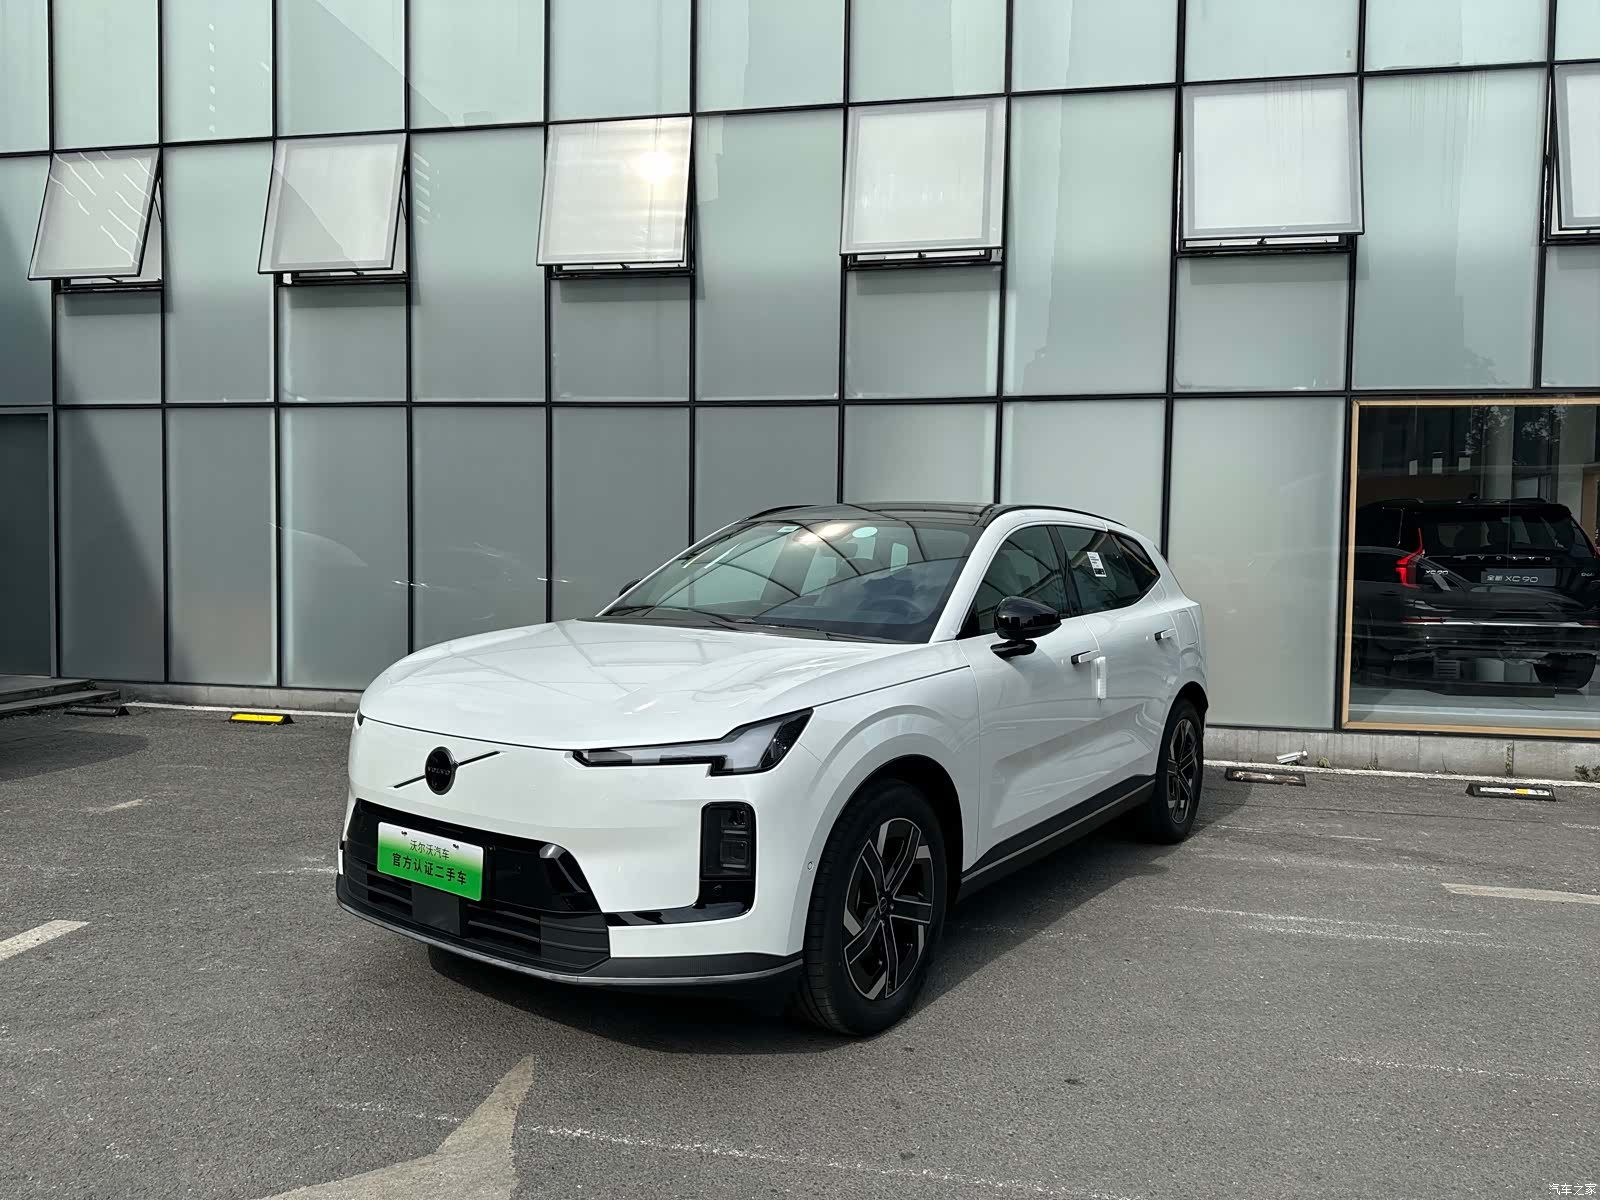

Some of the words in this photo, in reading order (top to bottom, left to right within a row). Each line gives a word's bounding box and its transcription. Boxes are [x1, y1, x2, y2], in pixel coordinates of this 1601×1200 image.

[409, 839, 450, 861] 沃尔沃汽车
[393, 853, 467, 885] 官方认证二手车
